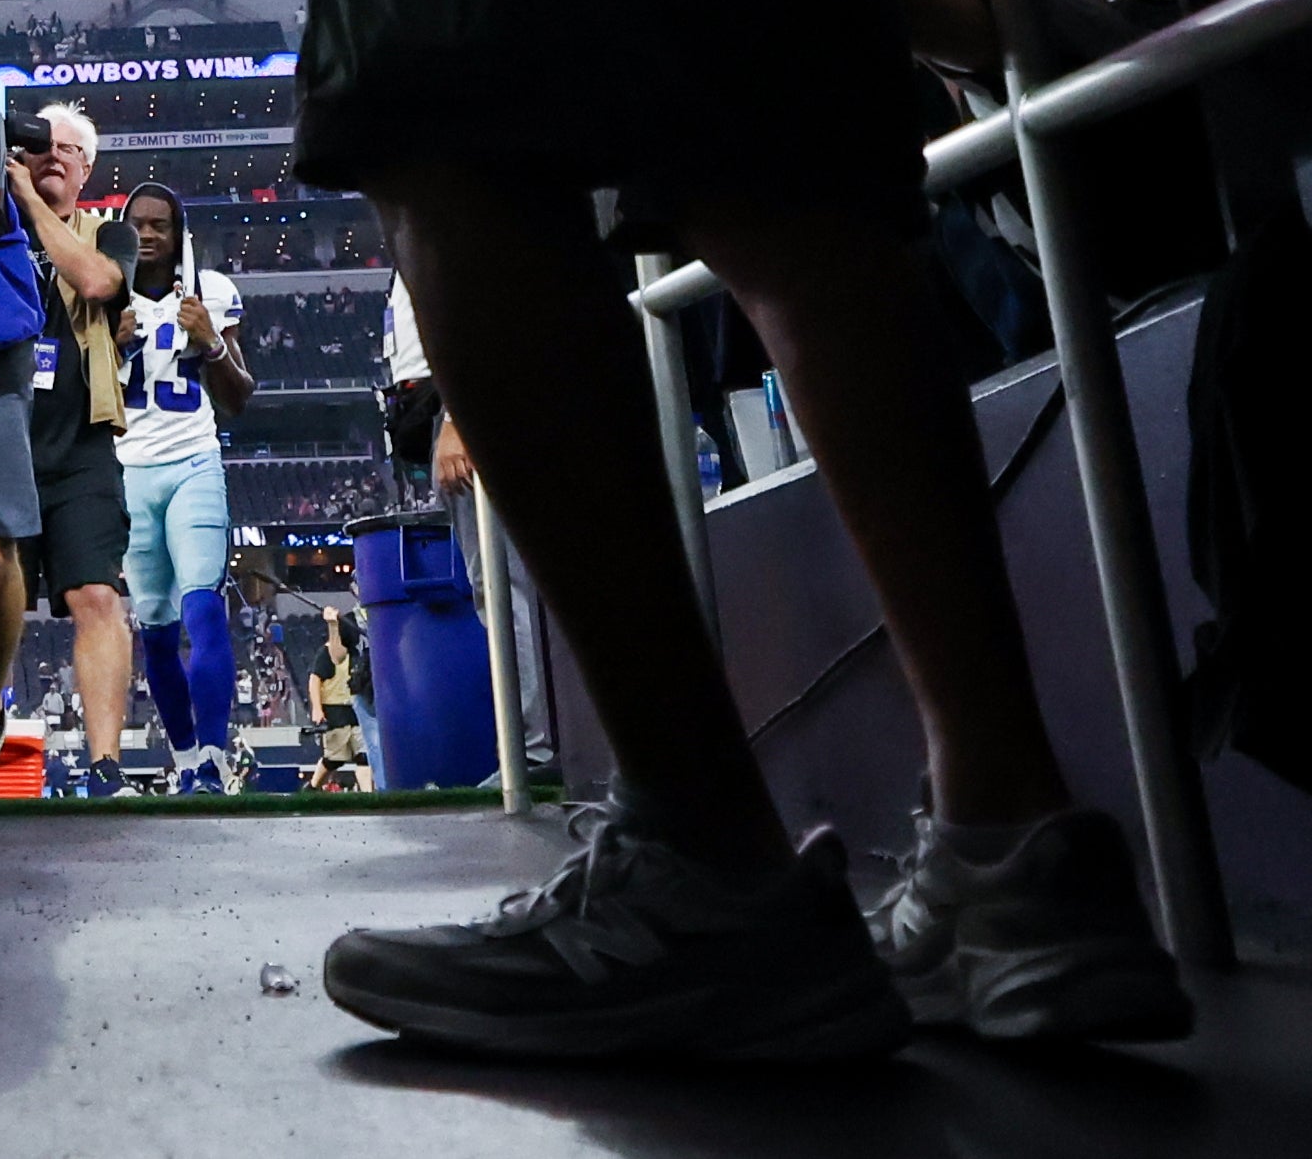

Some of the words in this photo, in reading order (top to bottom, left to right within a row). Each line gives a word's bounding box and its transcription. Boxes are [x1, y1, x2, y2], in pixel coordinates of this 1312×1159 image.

[33, 59, 179, 85] COWBOYS
[110, 137, 124, 148] 22
[128, 134, 178, 146] EMMITT
[182, 132, 223, 145] SMITH
